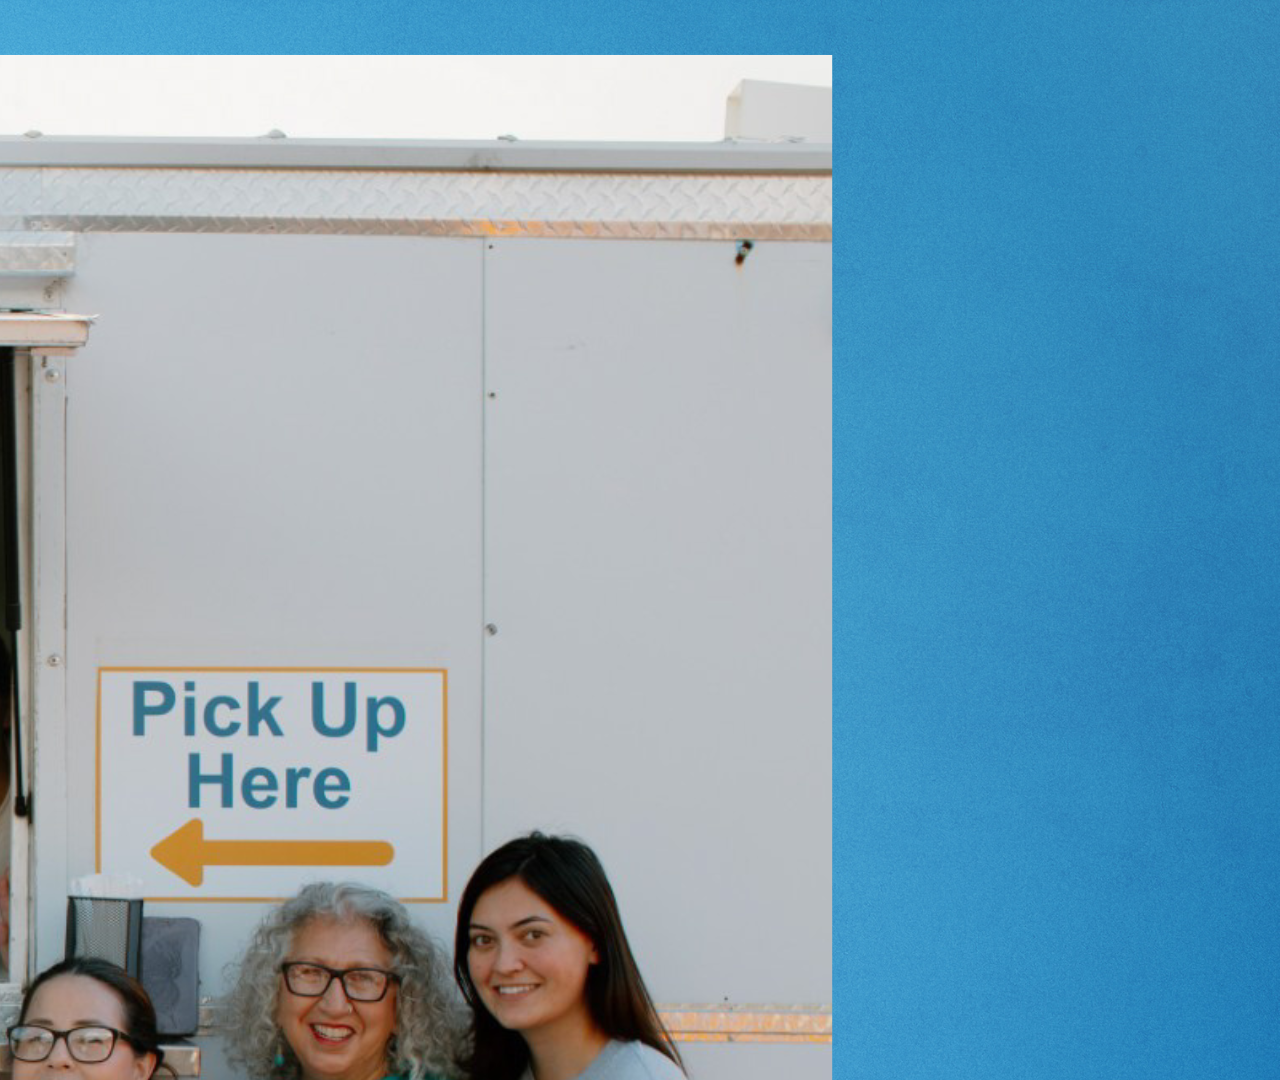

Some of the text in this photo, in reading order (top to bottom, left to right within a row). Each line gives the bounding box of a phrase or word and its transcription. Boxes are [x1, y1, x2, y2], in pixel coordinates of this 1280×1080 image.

[132, 680, 406, 753] Pick Up
[187, 752, 352, 810] Here
